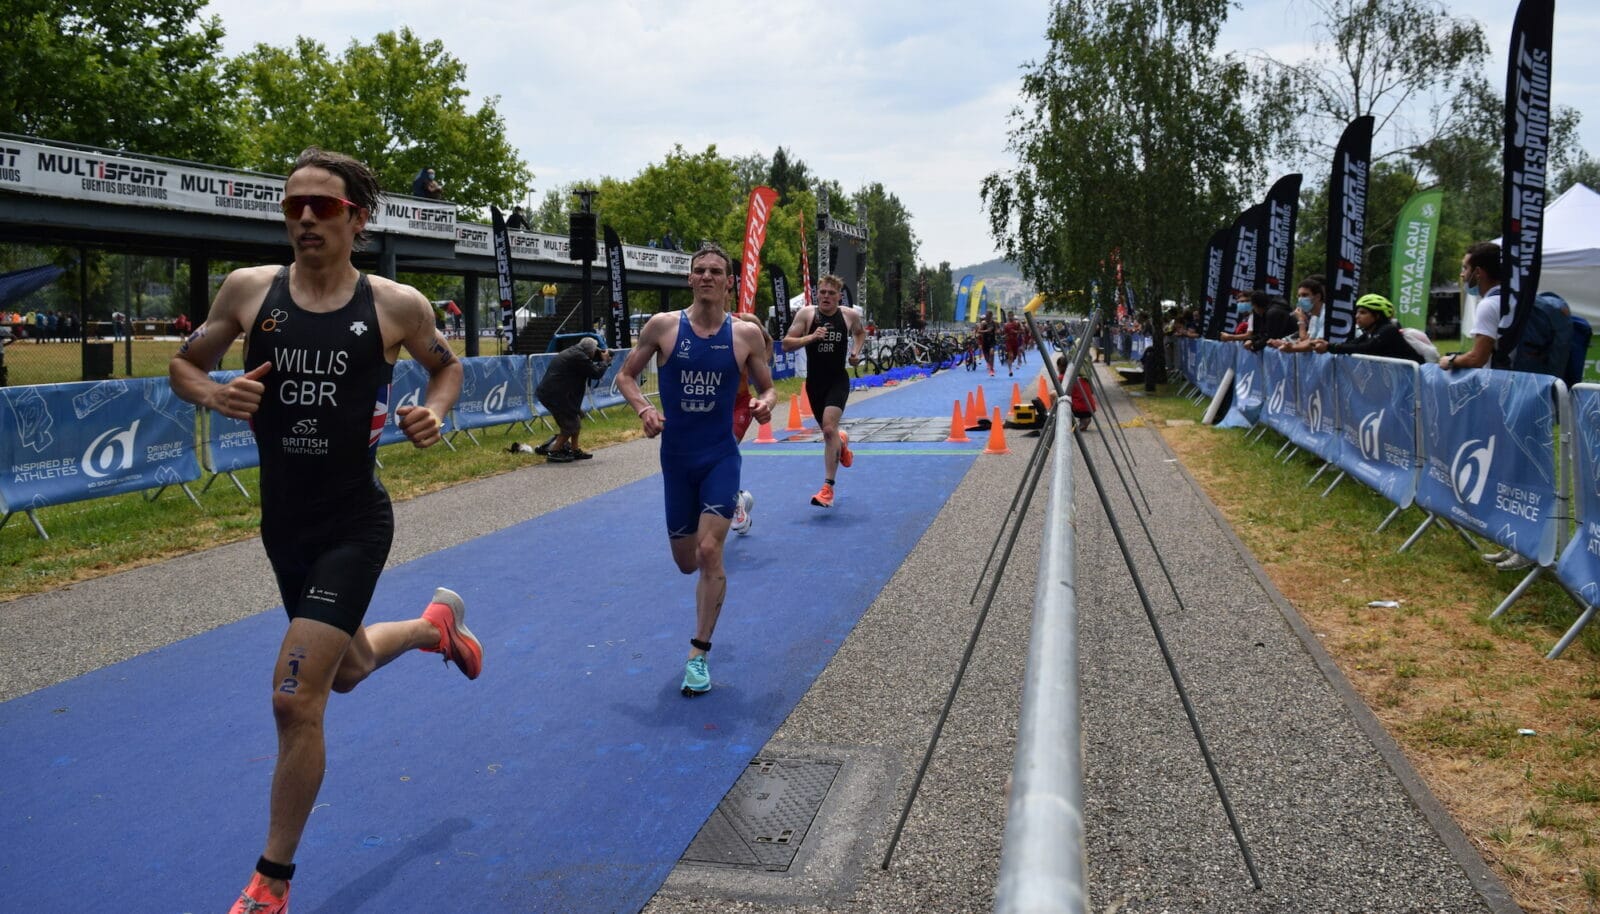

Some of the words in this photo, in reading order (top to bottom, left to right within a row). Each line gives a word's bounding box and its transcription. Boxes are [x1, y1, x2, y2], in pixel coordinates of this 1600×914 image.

[1522, 47, 1549, 188] DESPORTIVOS
[82, 179, 116, 194] EVENTOS
[117, 181, 168, 200] DESPORTIVOS
[1354, 160, 1367, 245] DESPORTIVOS
[456, 227, 488, 242] TiSPORT
[509, 234, 540, 248] TiSPORT
[1280, 203, 1292, 266] DESPORTIVOS
[544, 239, 571, 252] MULTiS
[1399, 258, 1415, 314] GRAVA
[1407, 221, 1422, 257] AQUI
[1224, 226, 1258, 334] ULTiSPORT
[495, 230, 514, 349] ULTiSPORT
[1412, 281, 1424, 304] TUA
[1410, 305, 1421, 316] A
[825, 331, 842, 343] EBB
[817, 343, 834, 353] GBR
[274, 347, 349, 376] WILLIS
[681, 370, 722, 386] MAIN
[279, 379, 338, 407] GBR
[683, 385, 716, 396] GBR
[220, 437, 256, 449] ATHLETE
[282, 436, 329, 449] BRITISH
[283, 447, 329, 455] TRIATHLON
[146, 448, 183, 463] SCIENCE
[12, 459, 61, 473] INSPIRED
[62, 457, 76, 467] BY
[14, 465, 78, 484] ATHLETES
[1497, 482, 1527, 502] DRIVEN
[1528, 492, 1541, 505] BY
[1495, 495, 1540, 522] SCIENCE
